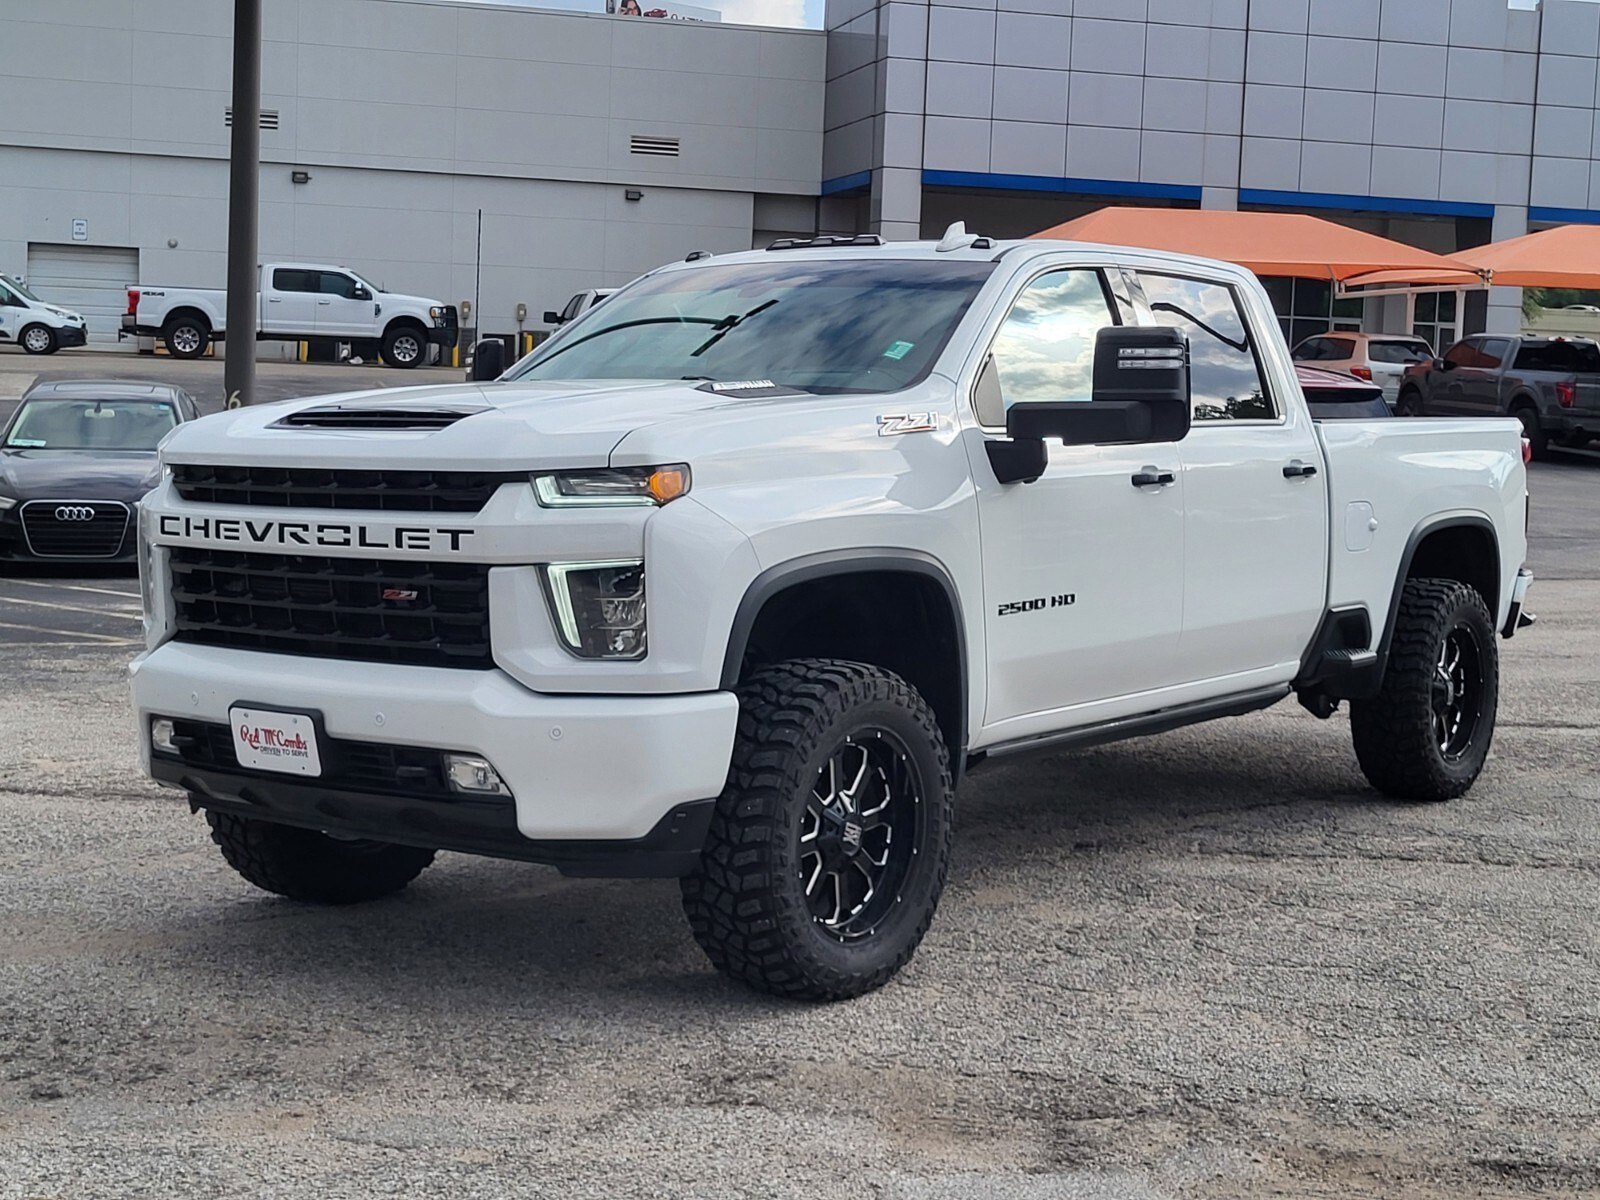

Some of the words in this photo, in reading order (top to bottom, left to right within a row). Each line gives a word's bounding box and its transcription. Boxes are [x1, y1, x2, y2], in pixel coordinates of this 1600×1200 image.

[159, 515, 475, 551] CHEVROLET
[998, 598, 1046, 616] 2500
[1051, 593, 1076, 608] HD
[240, 724, 261, 750] Red
[261, 727, 308, 750] McCombs
[260, 746, 281, 756] DRIVEN
[291, 750, 309, 758] SERVE
